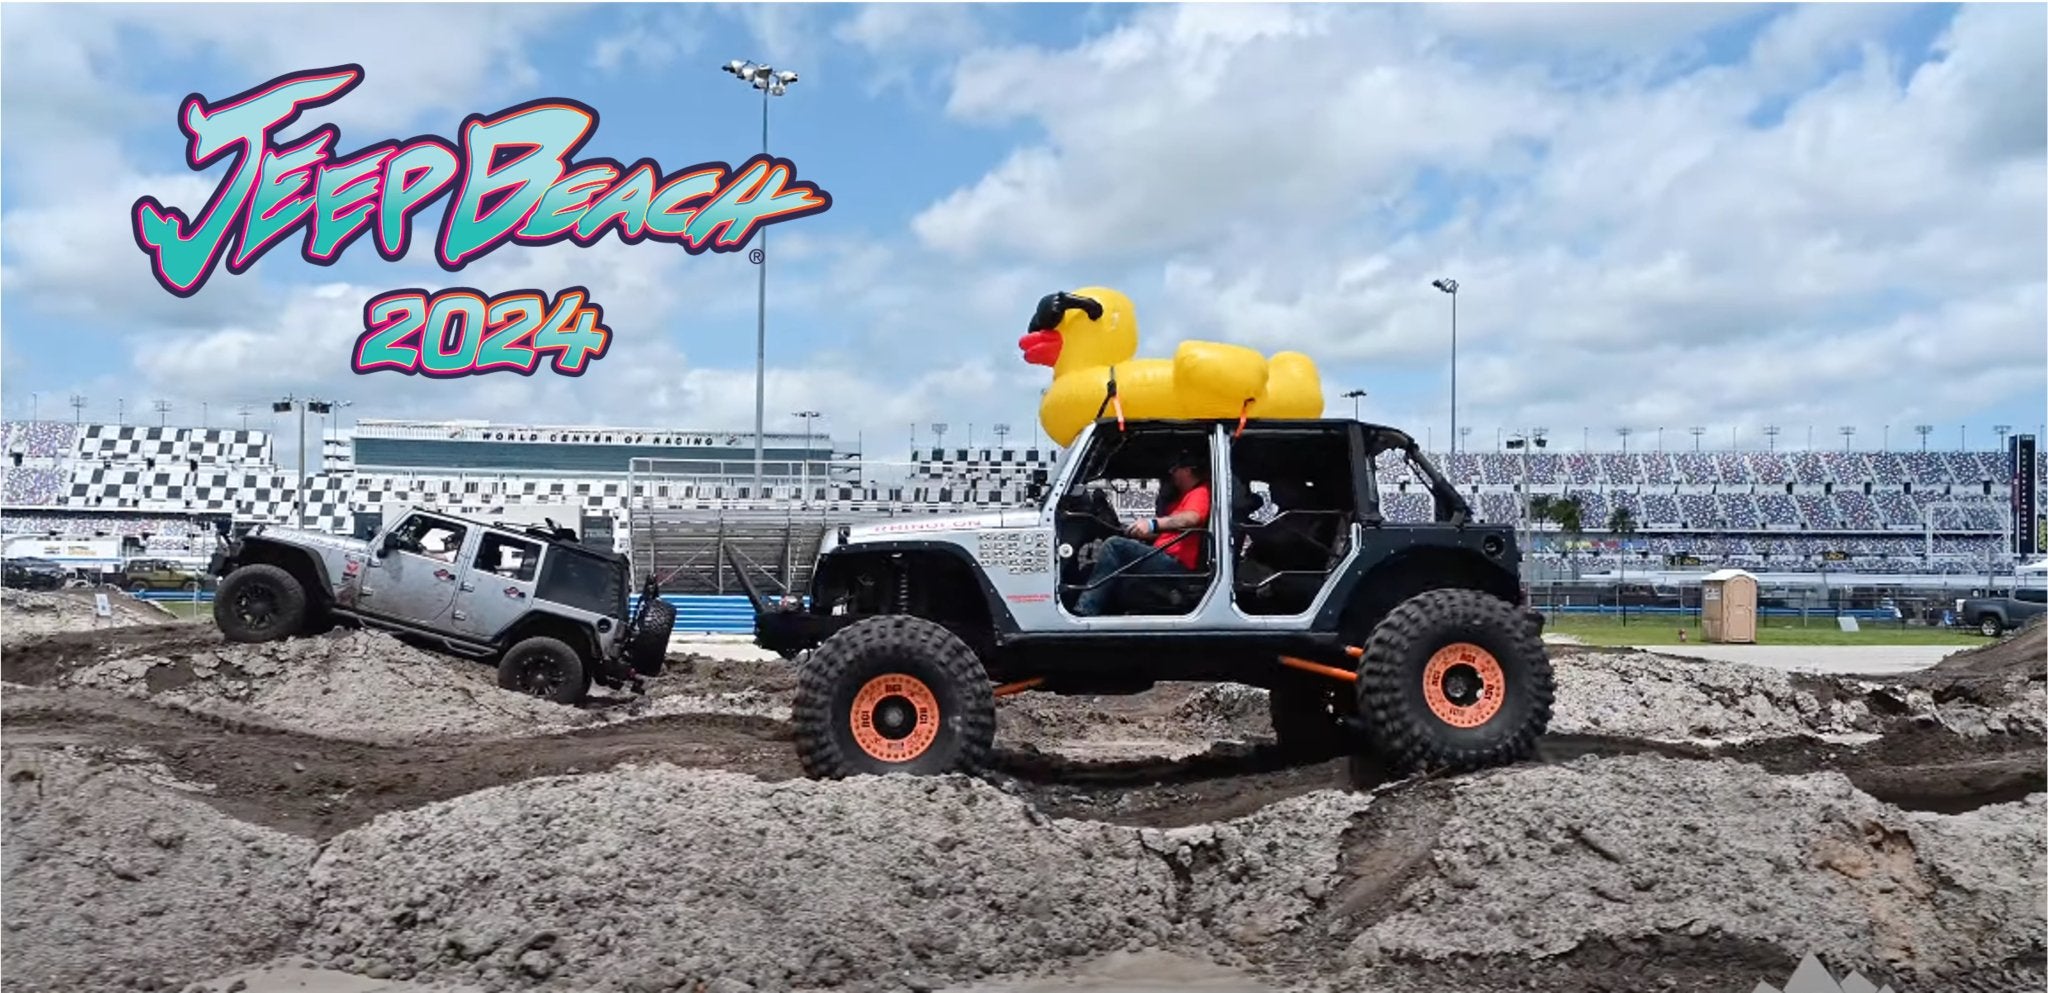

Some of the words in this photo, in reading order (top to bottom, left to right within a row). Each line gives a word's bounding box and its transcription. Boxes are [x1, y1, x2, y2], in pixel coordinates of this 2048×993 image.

[482, 432, 537, 441] WORLD
[550, 433, 612, 443] CENTER
[624, 435, 643, 444] OF
[653, 436, 713, 446] RACING
